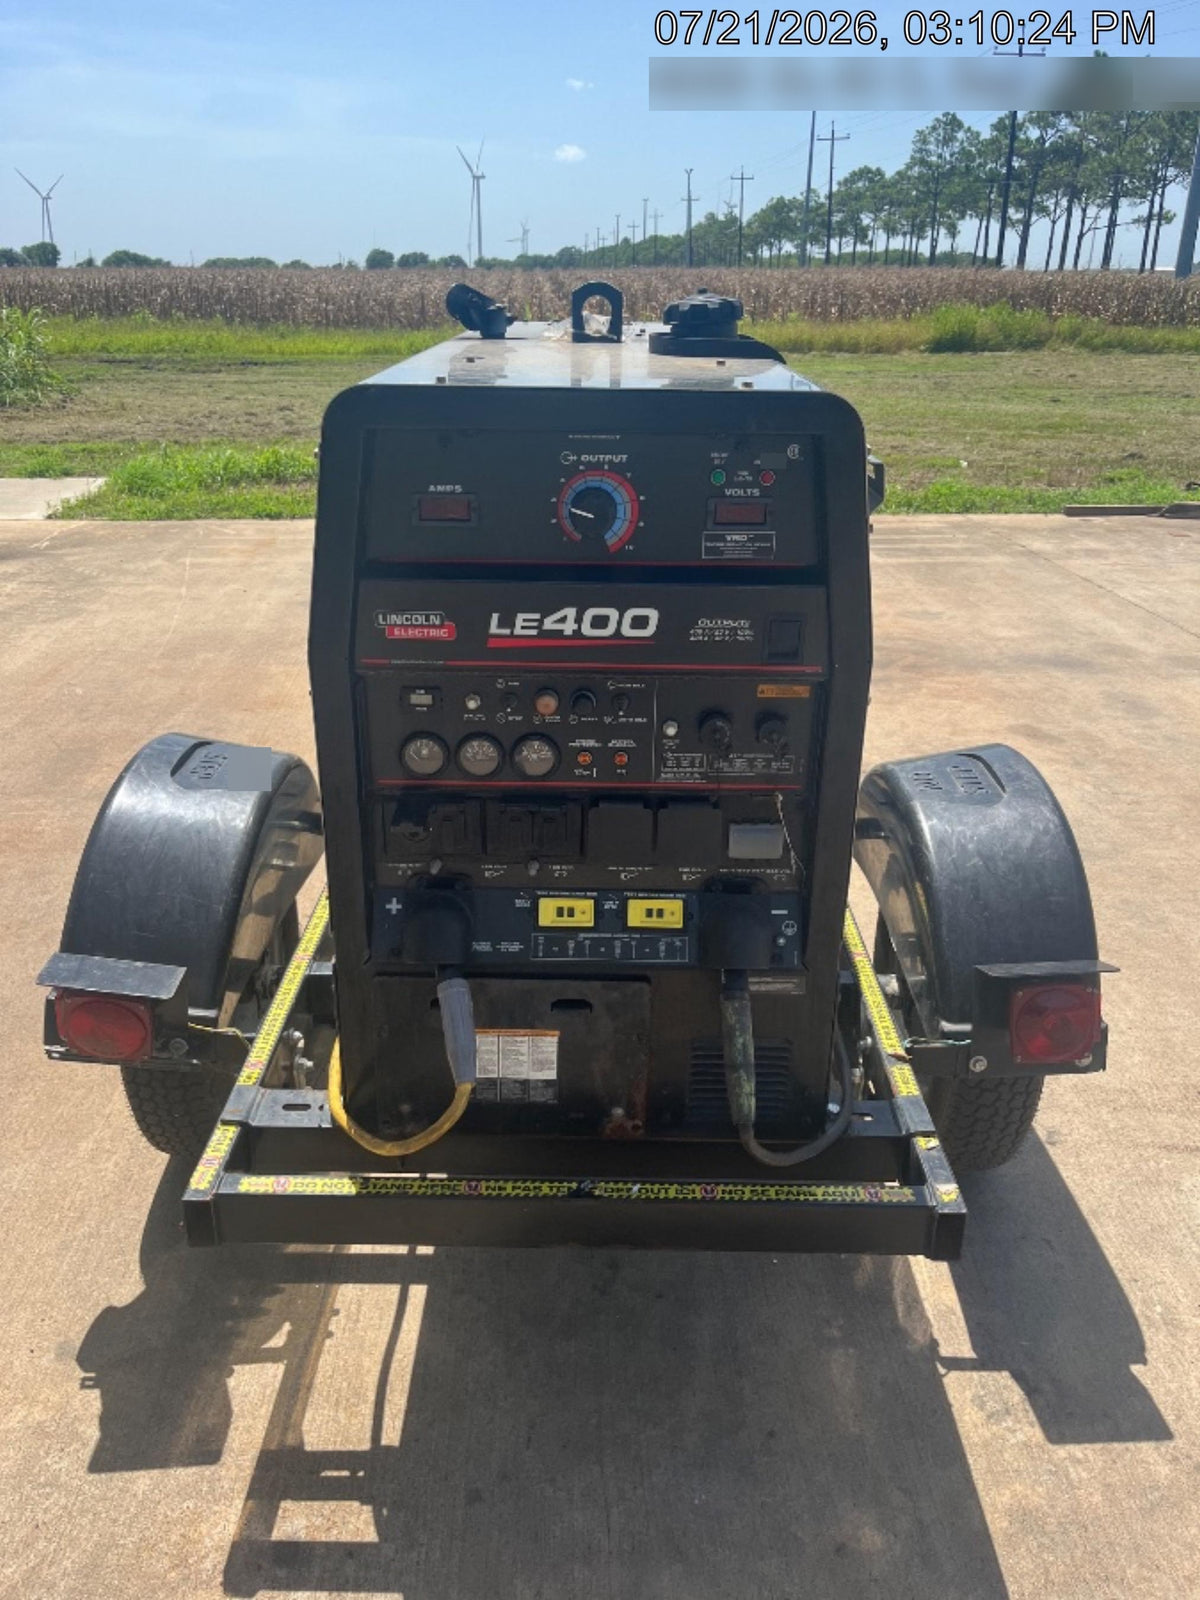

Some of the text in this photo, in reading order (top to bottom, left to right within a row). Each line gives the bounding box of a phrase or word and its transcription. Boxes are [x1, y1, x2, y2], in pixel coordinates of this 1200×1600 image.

[581, 454, 628, 463] OUTPUT
[429, 484, 463, 493] AMPS
[725, 488, 760, 497] VOLTS
[378, 614, 440, 625] LINCOLN
[489, 607, 660, 637] LE400
[393, 627, 449, 638] ELECTRIC
[293, 1181, 317, 1190] DO
[321, 1181, 353, 1190] NOT
[721, 1188, 745, 1197] NO
[749, 1188, 771, 1197] SE
[775, 1188, 818, 1198] PARE
